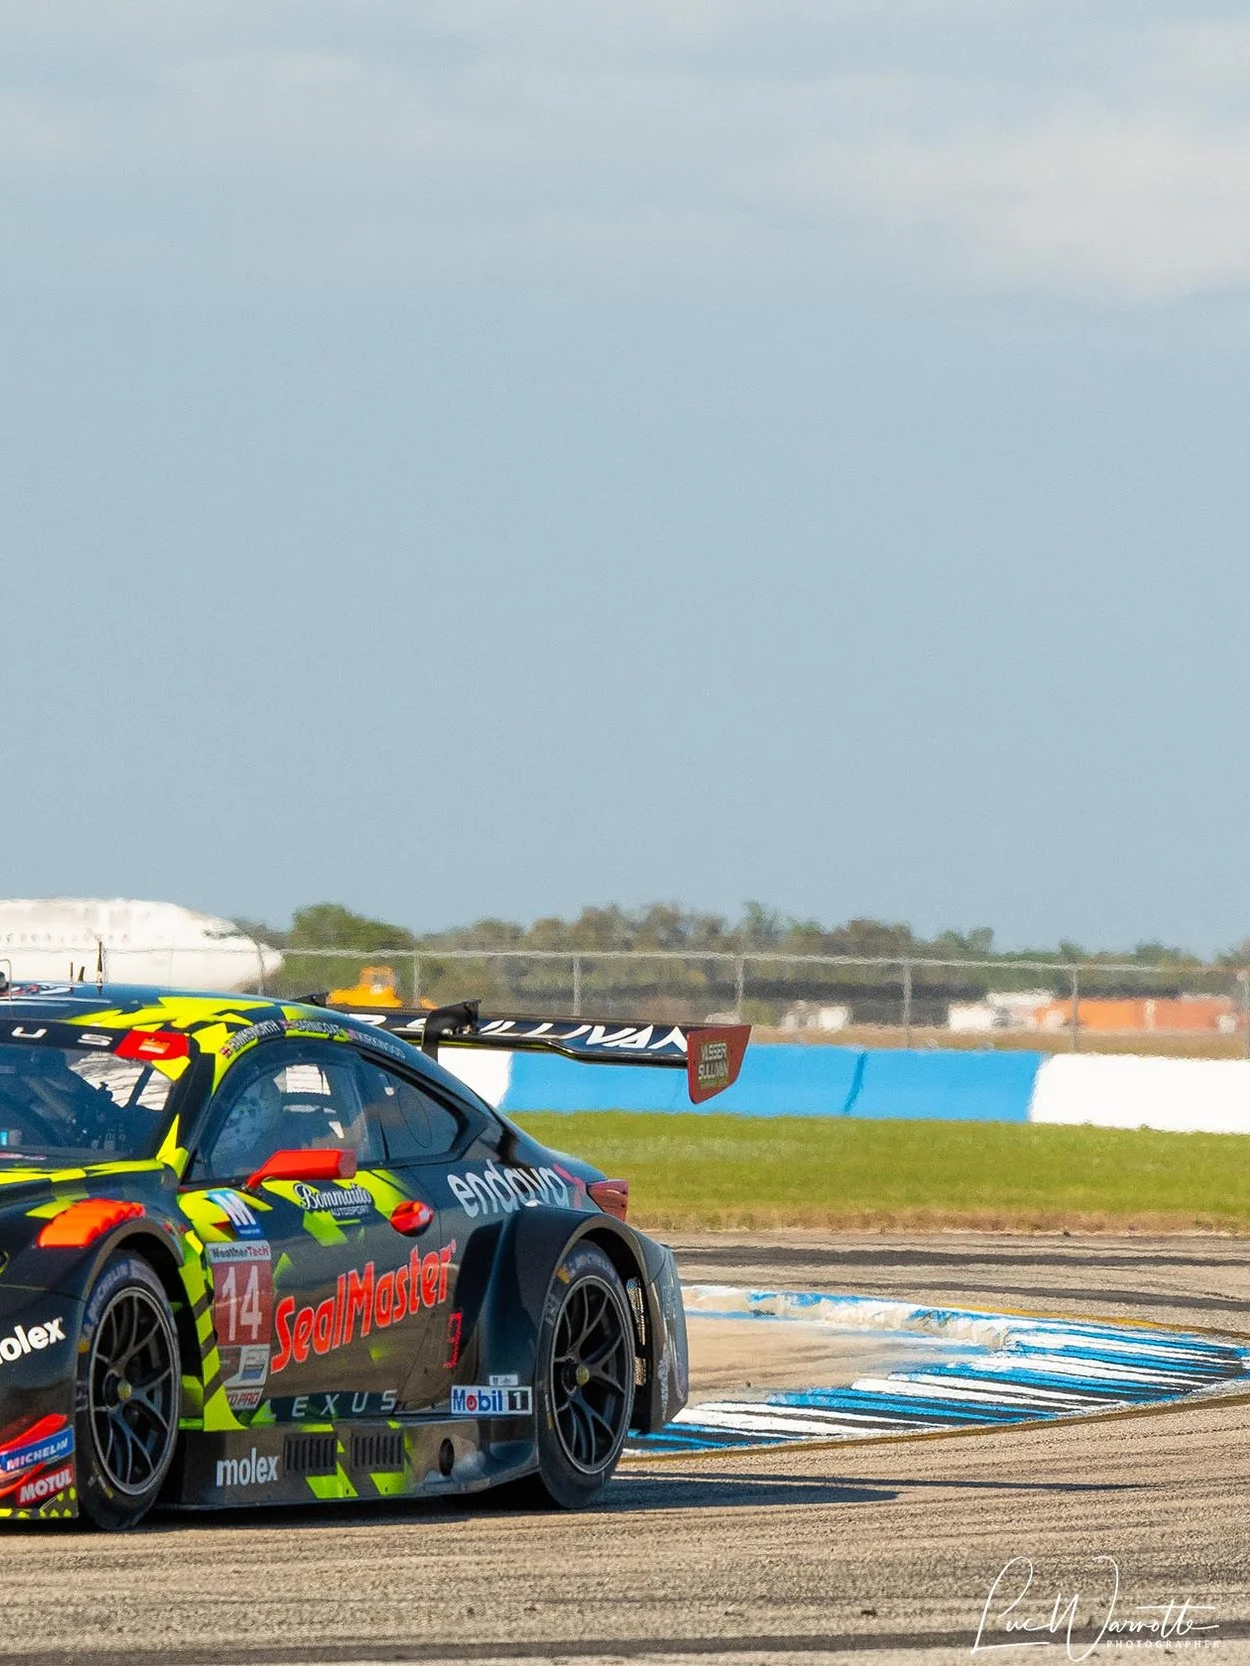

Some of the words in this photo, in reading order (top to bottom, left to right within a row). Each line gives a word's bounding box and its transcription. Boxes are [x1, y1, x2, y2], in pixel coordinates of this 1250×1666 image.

[701, 1042, 727, 1061] VASSER
[698, 1060, 729, 1080] SULLIVAN
[447, 1158, 570, 1218] endava
[211, 1192, 256, 1227] M
[209, 1245, 270, 1258] WeatherTech
[222, 1265, 262, 1342] 14
[270, 1244, 452, 1375] SealMaster
[263, 1389, 398, 1419] LEXUS
[453, 1389, 503, 1412] Mobil
[513, 1391, 522, 1410] 1
[6, 1437, 69, 1472] MICHELIN
[216, 1447, 280, 1488] molex
[19, 1468, 72, 1504] MOTUL
